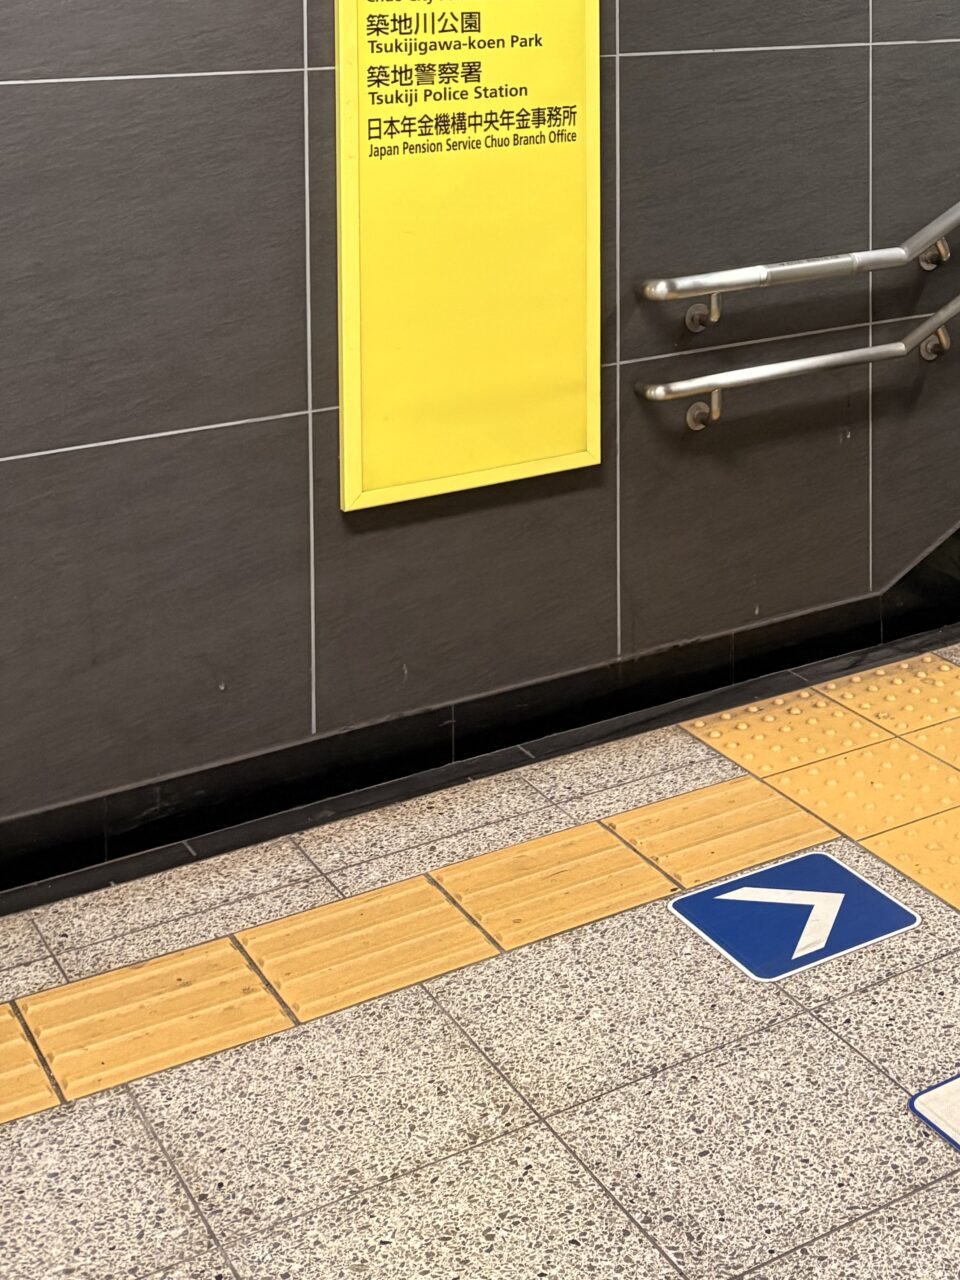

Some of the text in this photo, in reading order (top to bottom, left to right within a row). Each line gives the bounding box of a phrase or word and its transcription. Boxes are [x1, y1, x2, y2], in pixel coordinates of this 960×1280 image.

[366, 11, 481, 37] 築地川公園
[367, 33, 543, 56] Tsukijigawa-koen Park
[367, 60, 482, 88] 築地警察署
[368, 84, 528, 107] Tsukiji Police Station
[367, 105, 578, 141] 日本年金機構中央年金事務所
[368, 128, 577, 161] Japan Pension Service Chuo Branch Office
